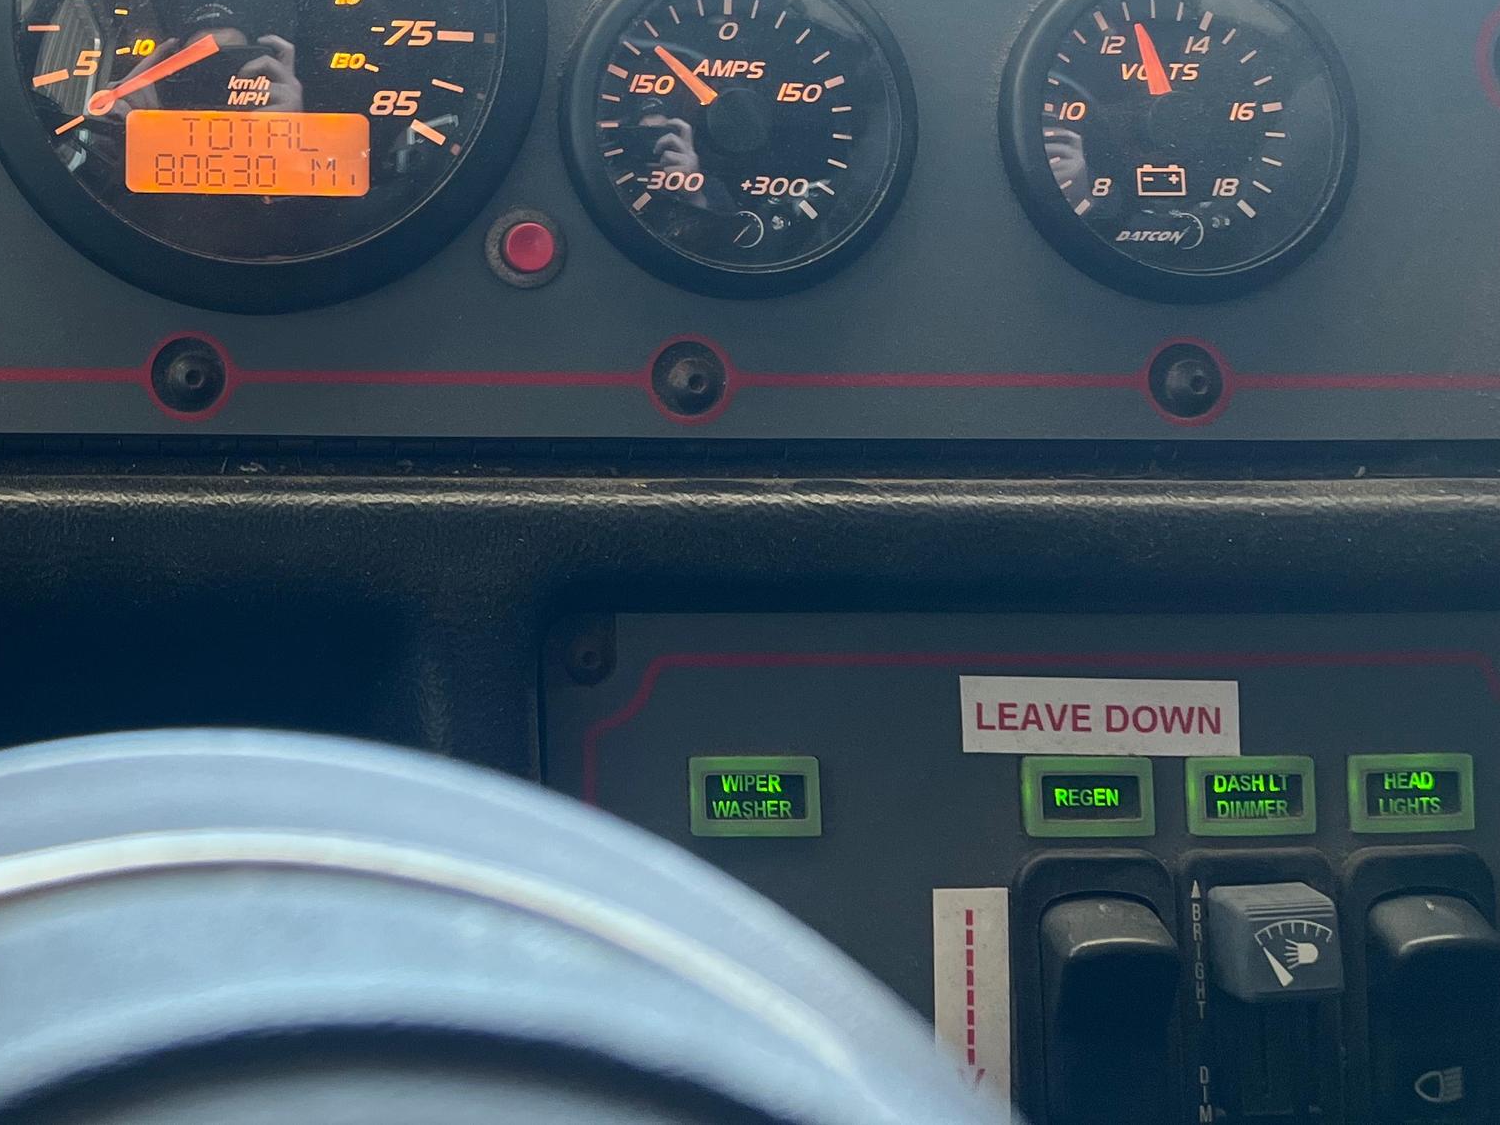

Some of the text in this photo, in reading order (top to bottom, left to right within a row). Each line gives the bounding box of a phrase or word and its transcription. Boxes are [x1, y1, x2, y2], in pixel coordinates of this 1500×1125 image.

[384, 21, 437, 47] 75
[718, 22, 739, 41] 0
[132, 39, 156, 57] 10
[1100, 35, 1126, 55] 12
[1184, 36, 1211, 54] 14
[73, 51, 102, 76] 5
[330, 53, 367, 70] 130
[693, 59, 766, 79] AMPS
[1121, 63, 1200, 81] VOTS
[227, 75, 271, 92] km/h
[629, 74, 675, 95] 150
[776, 83, 823, 103] 150
[227, 91, 270, 107] MPH
[369, 90, 421, 116] 85
[1058, 101, 1086, 121] 10
[1229, 102, 1256, 121] 16
[182, 118, 319, 151] TOTAL
[155, 153, 276, 187] 80630
[636, 171, 705, 192] -300
[740, 176, 809, 198] +300
[1091, 178, 1112, 197] 8
[1212, 178, 1239, 197] 18
[1115, 230, 1185, 244] DATCON
[975, 702, 1223, 735] LEAVE DOWN
[721, 774, 782, 794] WIPER
[1213, 774, 1289, 794] DASH LT
[1383, 771, 1435, 791] HEAD
[1053, 787, 1119, 808] REGEN
[1379, 796, 1442, 817] LIGHTS
[712, 800, 793, 820] WASHER
[1216, 798, 1289, 819] DIMMER
[1191, 902, 1206, 1020] BRIGHT
[1199, 1065, 1213, 1123] DIM
